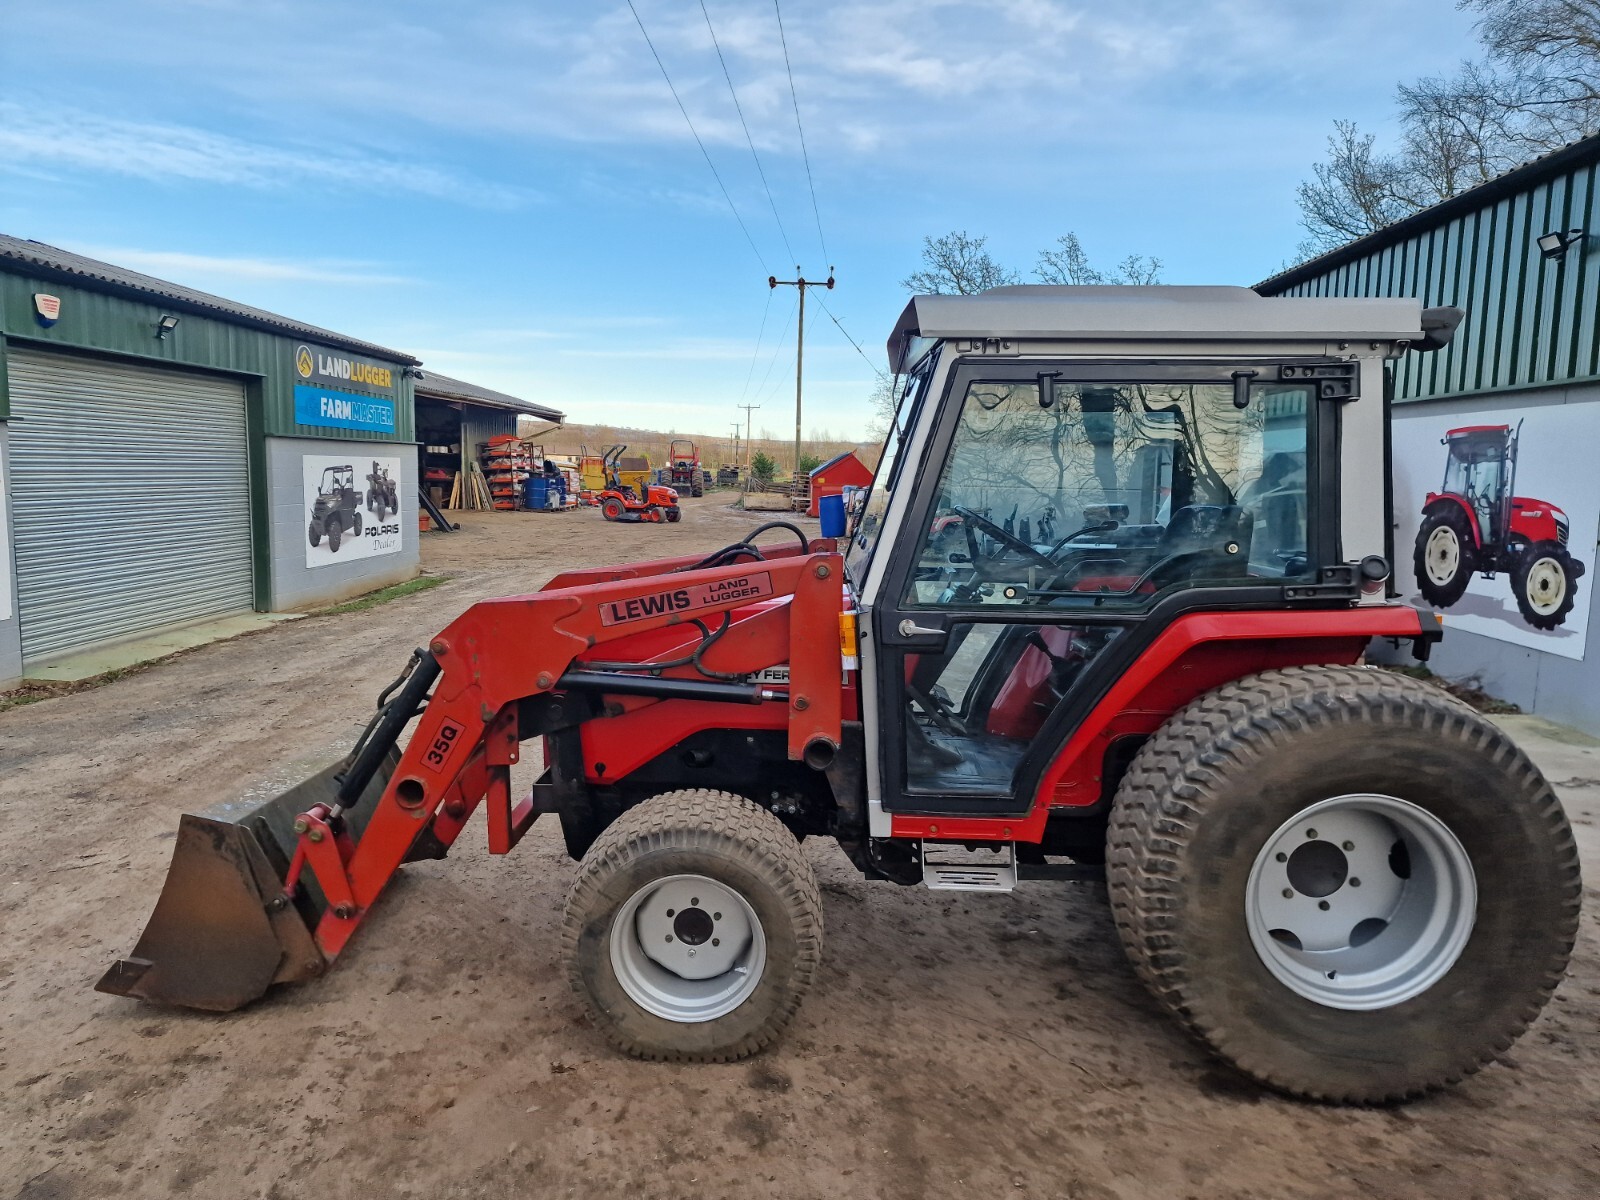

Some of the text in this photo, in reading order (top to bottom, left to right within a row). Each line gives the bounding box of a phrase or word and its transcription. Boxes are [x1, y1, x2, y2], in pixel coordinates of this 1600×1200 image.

[365, 523, 399, 537] POLARIS
[373, 535, 396, 551] Dealer
[709, 578, 749, 593] LAND
[703, 586, 760, 604] LUGGER
[611, 590, 691, 622] LEWIS
[427, 725, 458, 765] 35Q
